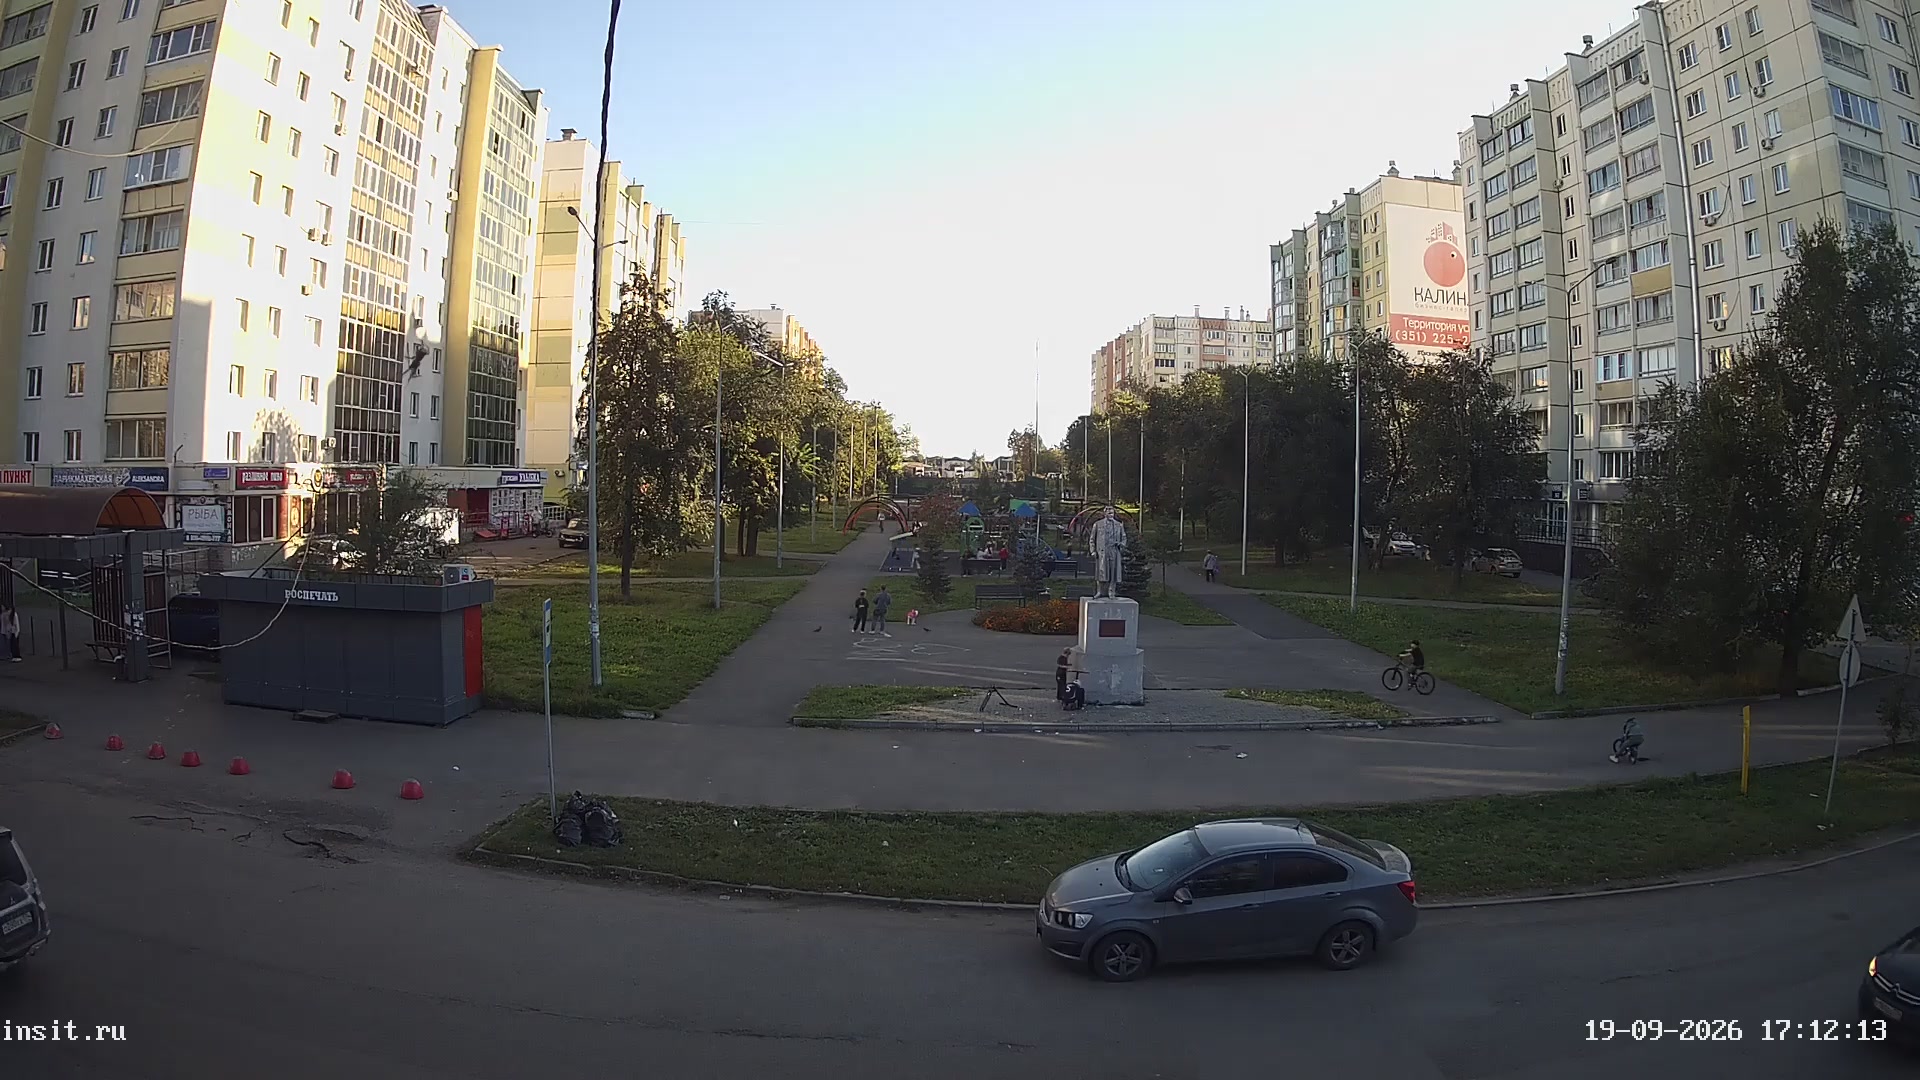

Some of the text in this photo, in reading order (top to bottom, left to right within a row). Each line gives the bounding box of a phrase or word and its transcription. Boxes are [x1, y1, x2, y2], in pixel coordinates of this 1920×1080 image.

[1414, 287, 1468, 306] КАЛИН
[1402, 317, 1456, 332] Территория
[1395, 330, 1427, 343] (351)
[3, 470, 31, 484] ПУНКТ
[53, 474, 113, 483] ПАРИКМАХЕРСКАЯ
[188, 508, 219, 520] РЫБА
[284, 589, 339, 602] РОСПЕЧАТЬ
